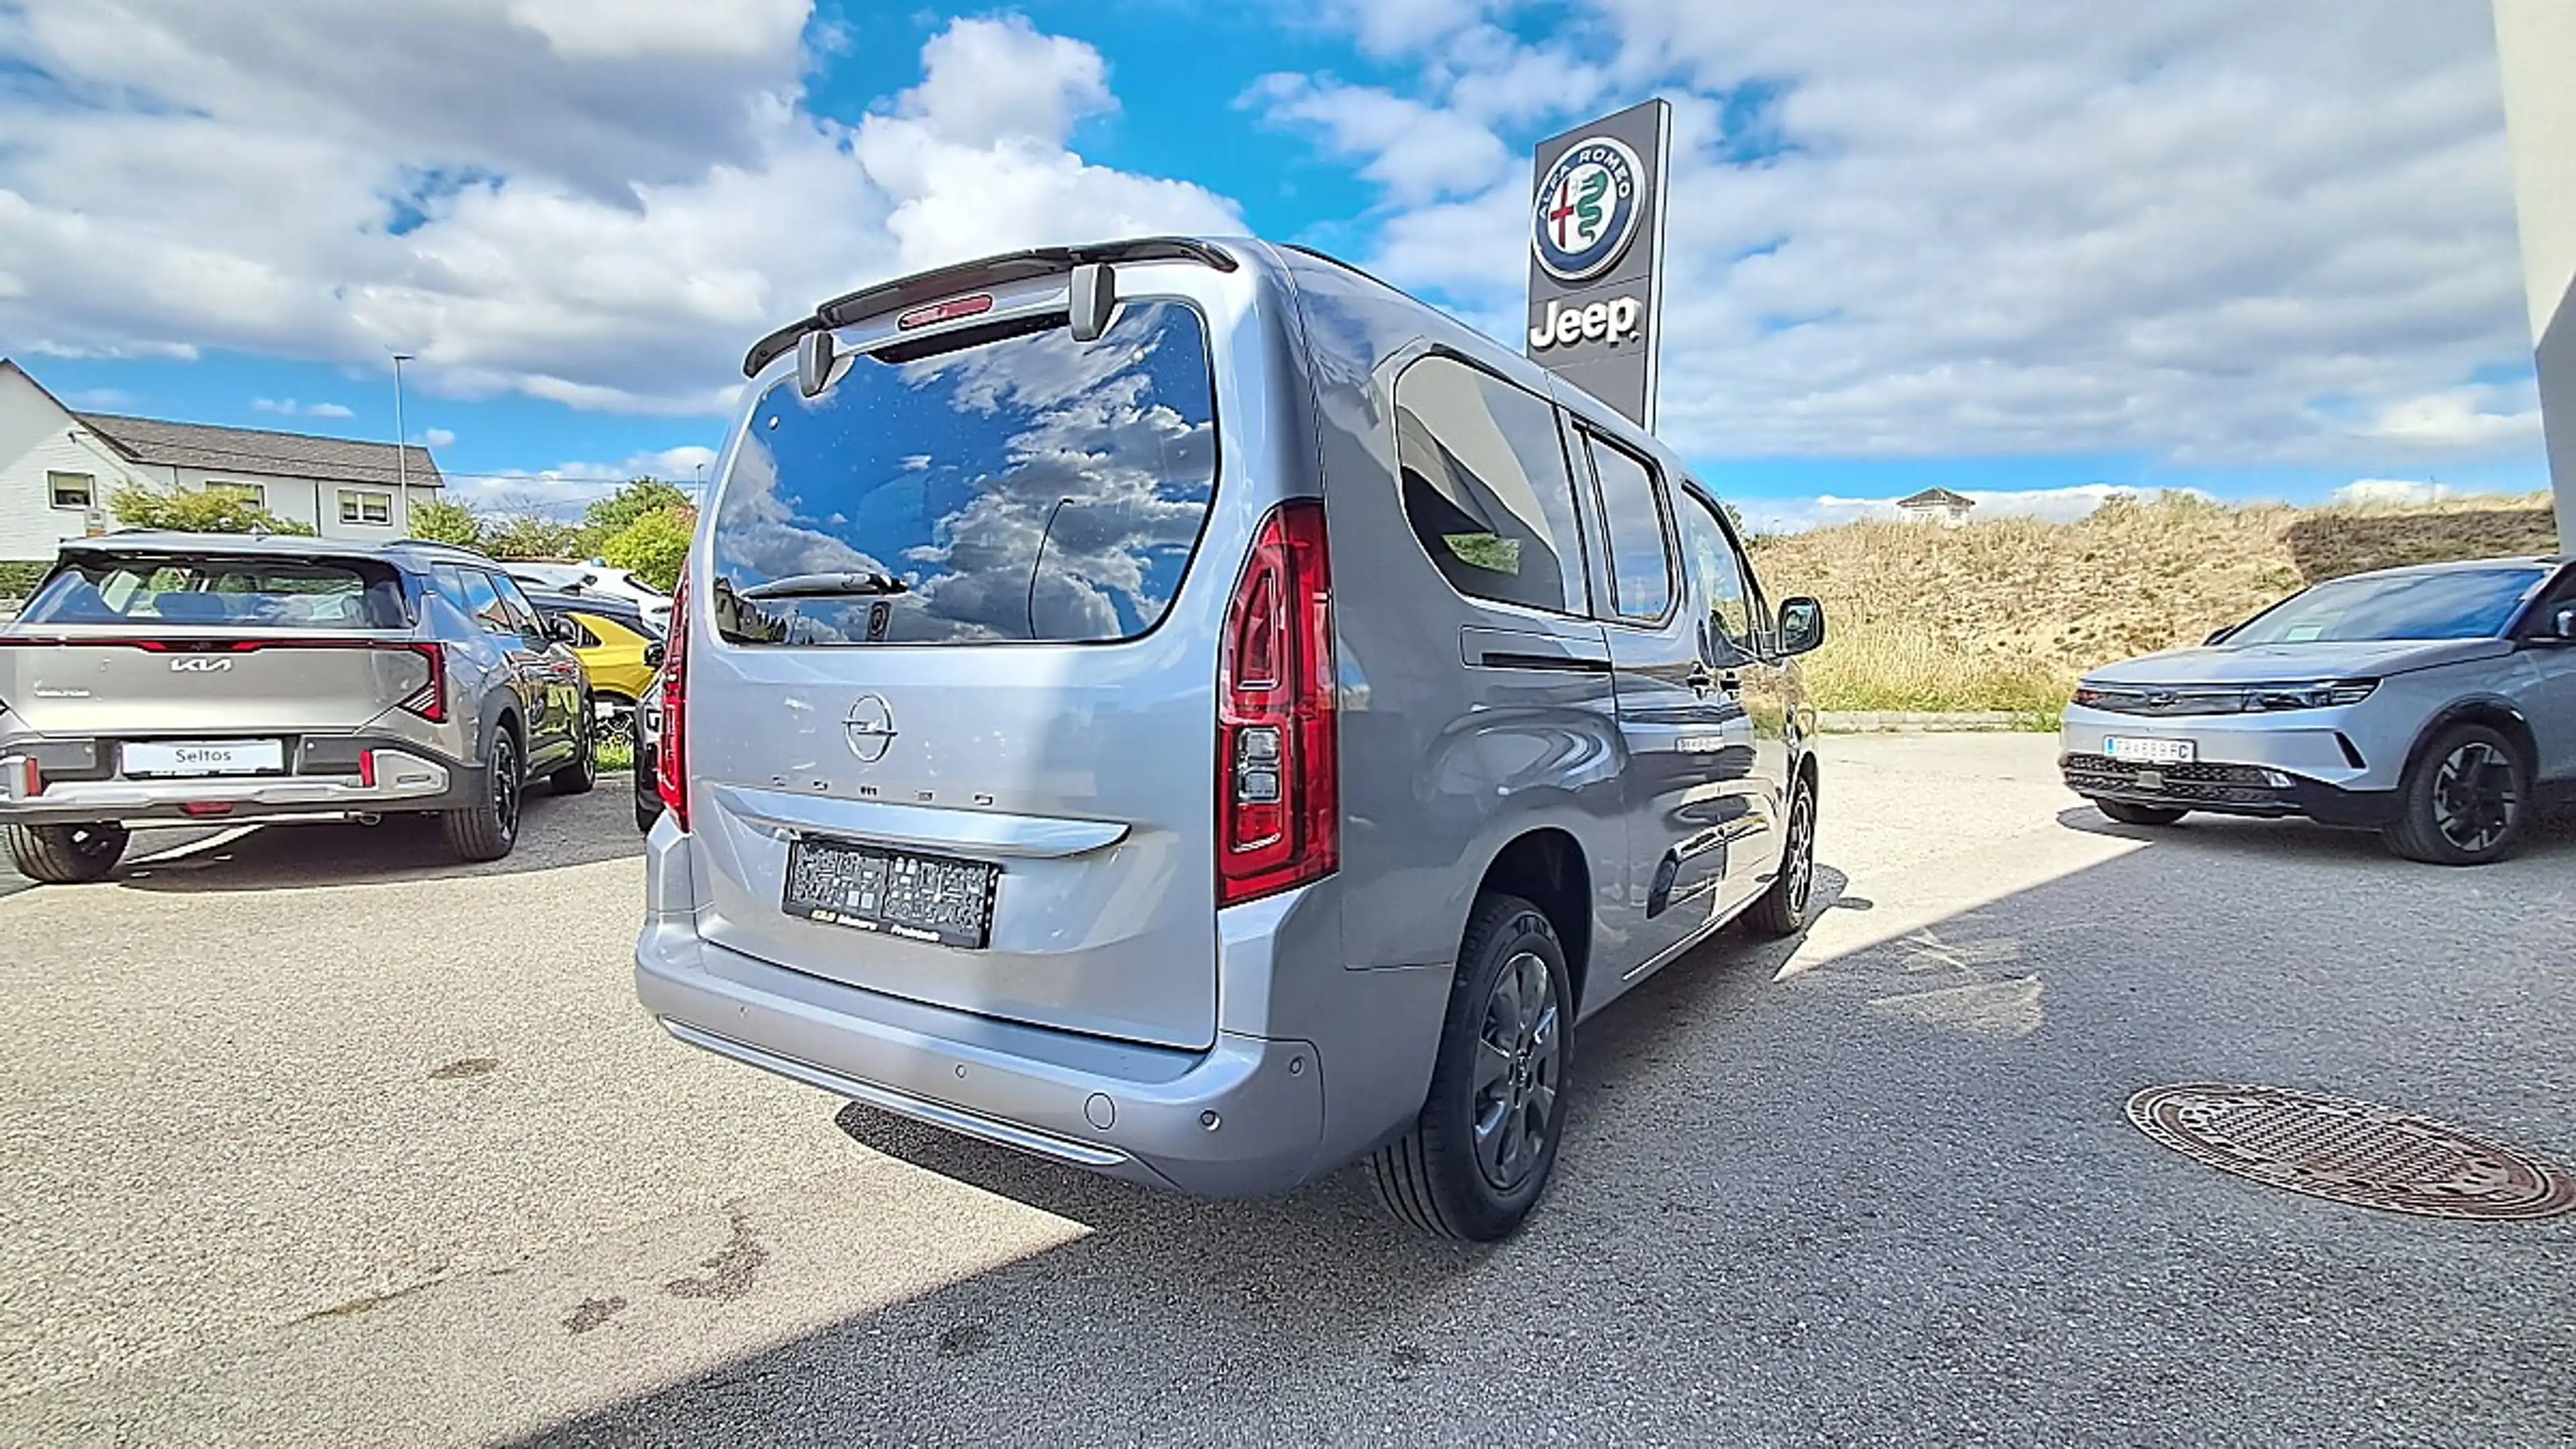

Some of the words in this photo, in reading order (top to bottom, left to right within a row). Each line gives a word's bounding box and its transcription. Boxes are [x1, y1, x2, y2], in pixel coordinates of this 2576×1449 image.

[1538, 166, 1572, 220] ALFA
[1578, 147, 1631, 199] ROMEO
[176, 749, 231, 763] Seltos
